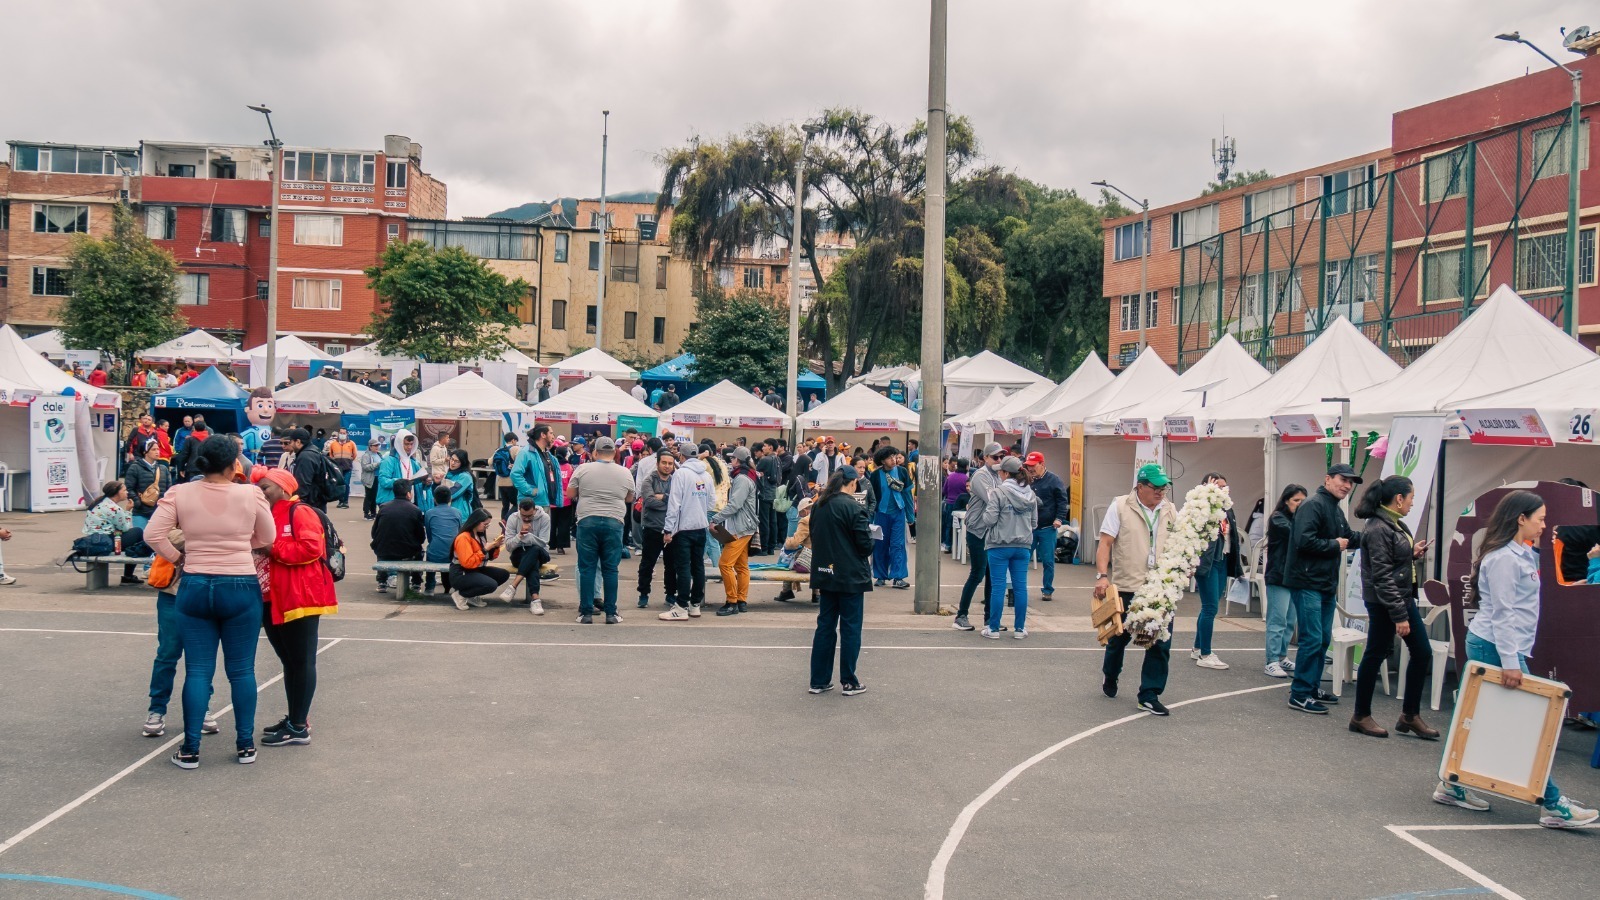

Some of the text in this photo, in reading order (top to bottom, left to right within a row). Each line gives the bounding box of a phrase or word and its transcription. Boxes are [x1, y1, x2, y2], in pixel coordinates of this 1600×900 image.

[331, 400, 339, 408] 14
[1206, 422, 1215, 436] 24
[1335, 416, 1342, 430] 2
[1478, 418, 1503, 429] ALCALDÍA
[1503, 419, 1522, 430] LOCAL
[1573, 414, 1591, 435] 26
[1460, 574, 1472, 607] ThinQ
